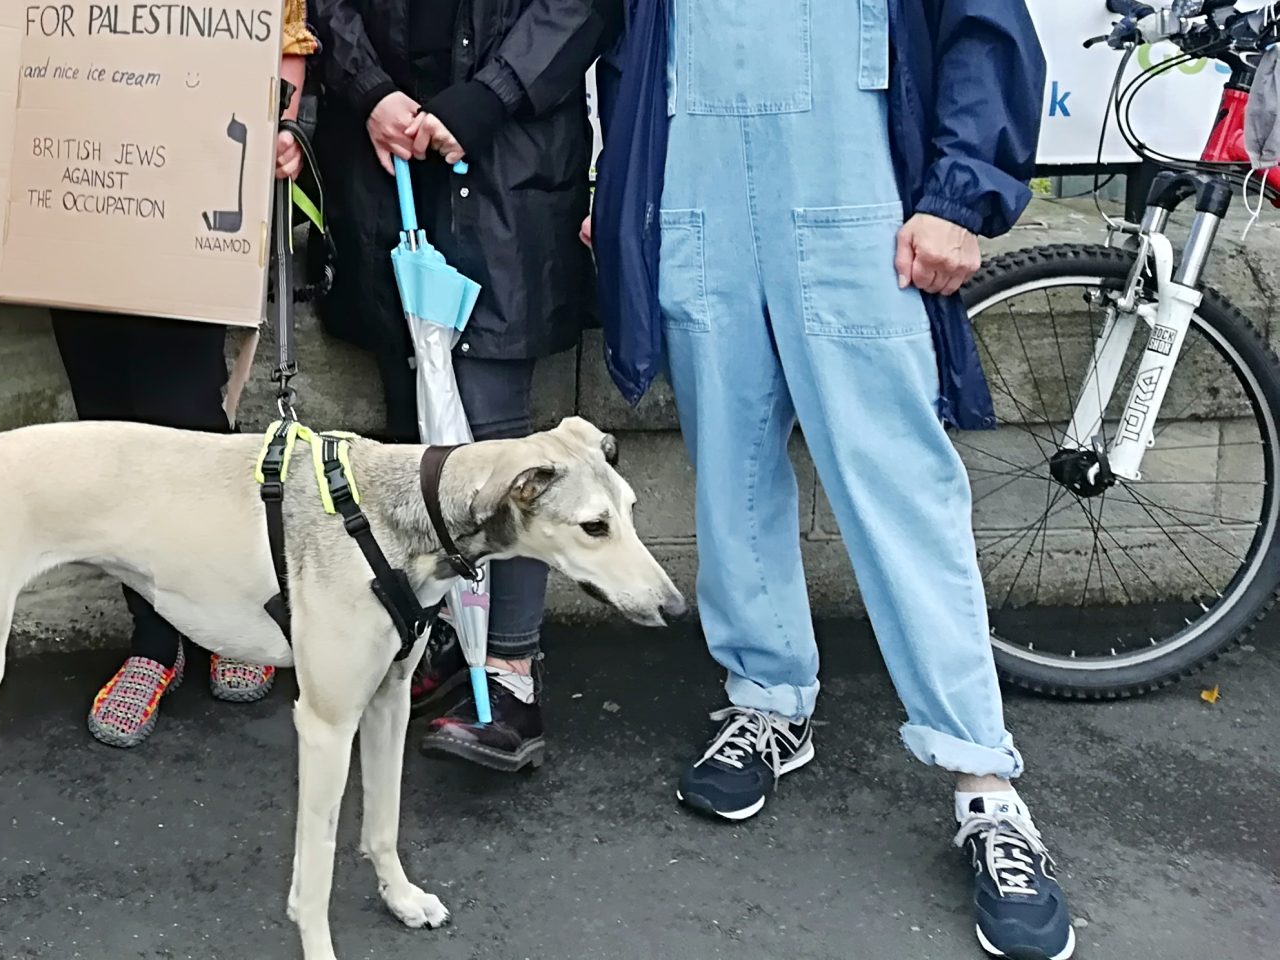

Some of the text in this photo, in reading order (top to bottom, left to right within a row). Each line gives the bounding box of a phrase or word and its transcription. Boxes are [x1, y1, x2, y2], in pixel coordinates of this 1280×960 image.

[26, 4, 273, 42] FOR PALESTINIANS
[24, 56, 161, 87] and nice ice cream
[33, 137, 166, 168] BRITISH JEWS
[61, 167, 129, 190] AGAINST
[27, 189, 165, 219] THE OCCUPATION
